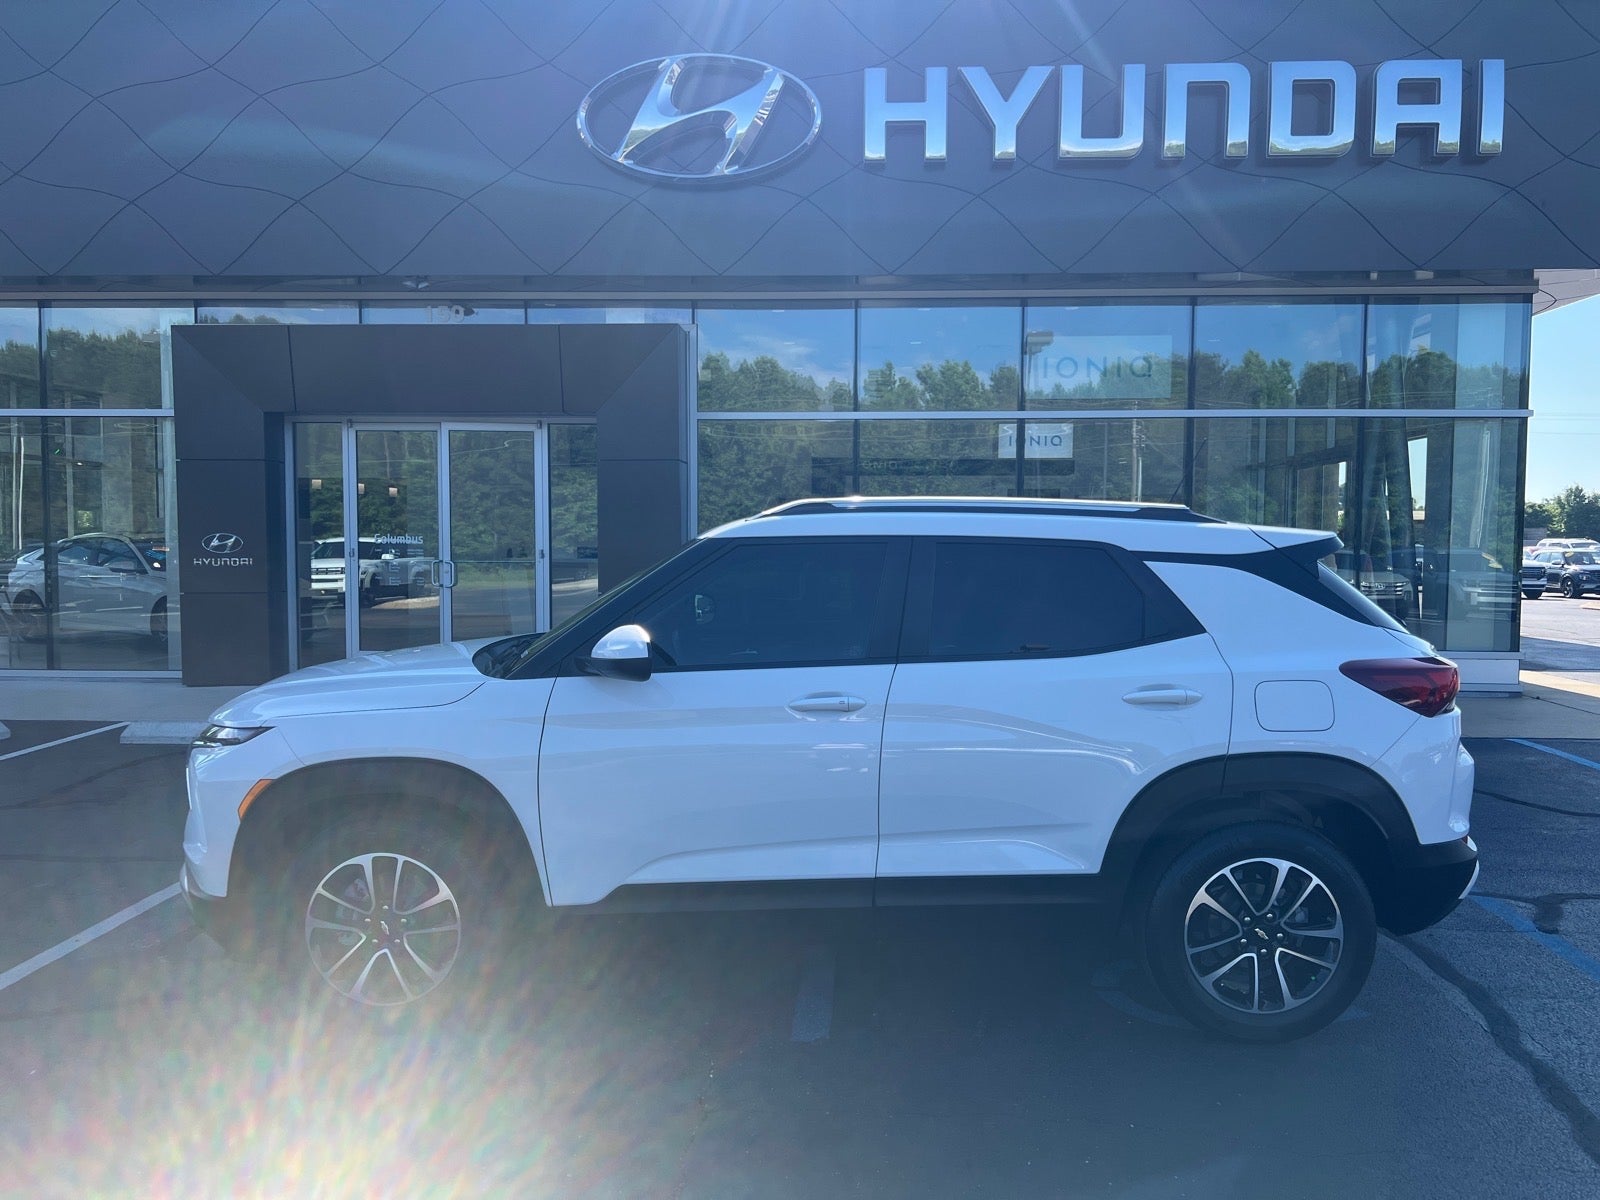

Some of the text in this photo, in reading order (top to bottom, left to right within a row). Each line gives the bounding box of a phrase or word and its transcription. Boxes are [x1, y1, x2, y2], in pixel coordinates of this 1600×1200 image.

[864, 59, 1505, 162] HYUNDAI
[1043, 356, 1153, 379] IONIQ
[1008, 435, 1063, 447] INIQ
[374, 533, 424, 544] Columbus
[193, 557, 254, 567] HYUNDAI
